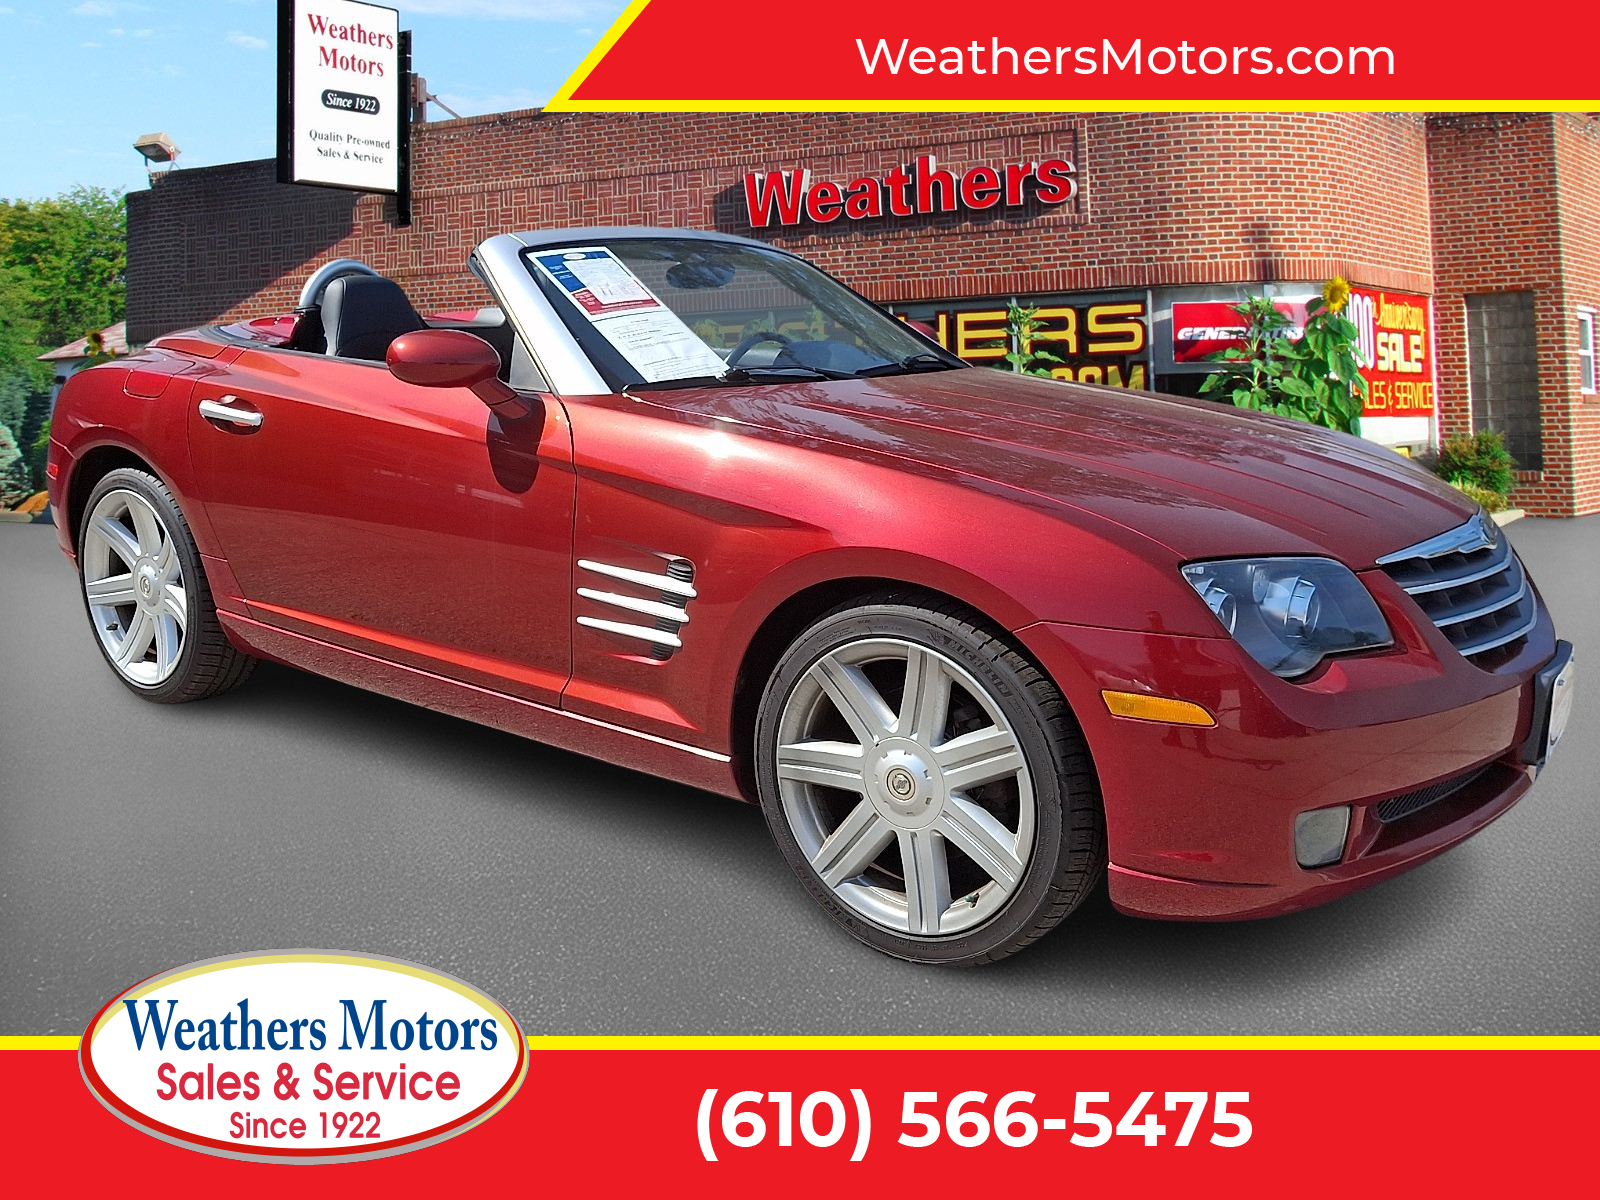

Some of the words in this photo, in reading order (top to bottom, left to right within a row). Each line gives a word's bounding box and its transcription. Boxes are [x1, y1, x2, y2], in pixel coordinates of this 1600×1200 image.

[307, 13, 394, 50] Weathers
[318, 45, 385, 78] Motors
[326, 92, 353, 108] Since
[355, 95, 377, 112] 1922
[309, 129, 343, 146] Quality
[346, 134, 391, 150] Pre-owned
[316, 146, 341, 159] Sales
[343, 150, 351, 160] &
[353, 152, 384, 165] Service
[743, 155, 1078, 228] Weathers
[1376, 331, 1423, 373] SALE
[1394, 382, 1434, 409] SERVICE
